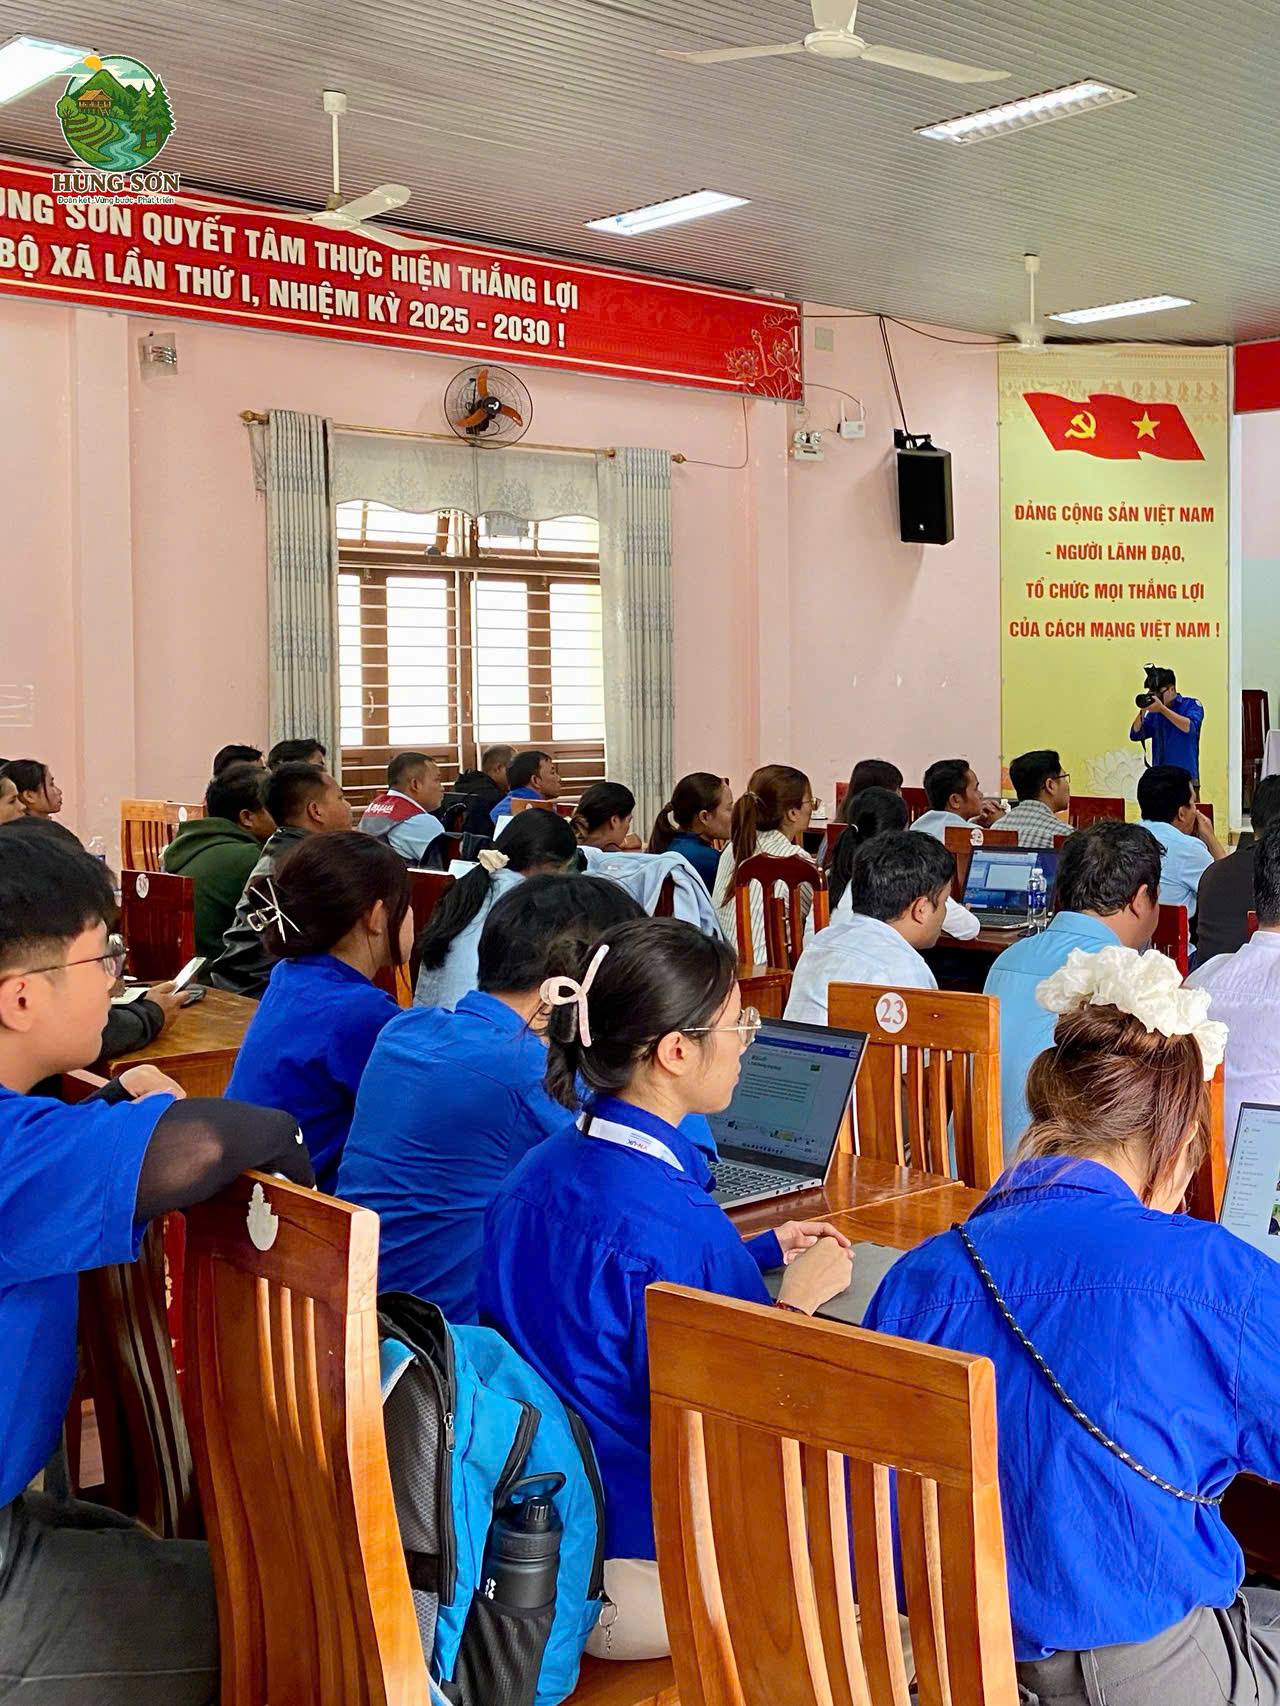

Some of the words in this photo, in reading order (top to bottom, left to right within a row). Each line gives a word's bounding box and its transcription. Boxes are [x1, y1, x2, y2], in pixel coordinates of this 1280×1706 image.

[143, 212, 236, 253] QUYẾT
[244, 228, 305, 265] TÂM
[314, 240, 383, 281] THỰC
[392, 253, 450, 291] HIỆN
[457, 262, 536, 303] THẮNG
[543, 280, 579, 313] LỢI
[50, 243, 95, 280] XÃ
[105, 246, 165, 290] LẦN
[175, 262, 235, 299] THỨ
[241, 274, 259, 307] I,
[270, 277, 359, 320] NHIỆM
[368, 291, 401, 324] KỲ
[409, 300, 470, 334] 2025
[493, 313, 550, 346] 2030
[1015, 500, 1056, 521] ĐẢNG
[1062, 503, 1103, 525] CỘNG
[1108, 501, 1138, 522] SẢN
[1144, 503, 1175, 526] VIỆT
[1180, 507, 1214, 522] NAM
[1056, 541, 1102, 561] NGƯỜI
[1107, 543, 1146, 561] LÃNH
[1151, 545, 1185, 564] ĐẠO,
[1026, 577, 1045, 599] TỔ
[1049, 580, 1089, 599] CHỨC
[1094, 583, 1123, 602] MỌI
[1128, 578, 1176, 600] THẮNG
[1182, 582, 1204, 602] LỢI
[1009, 617, 1039, 637] CỦA
[1045, 618, 1085, 638] CÁCH
[1090, 622, 1135, 641] MẠNG
[1140, 619, 1171, 641] VIỆT
[1176, 622, 1210, 638] NAM
[880, 997, 904, 1024] 23
